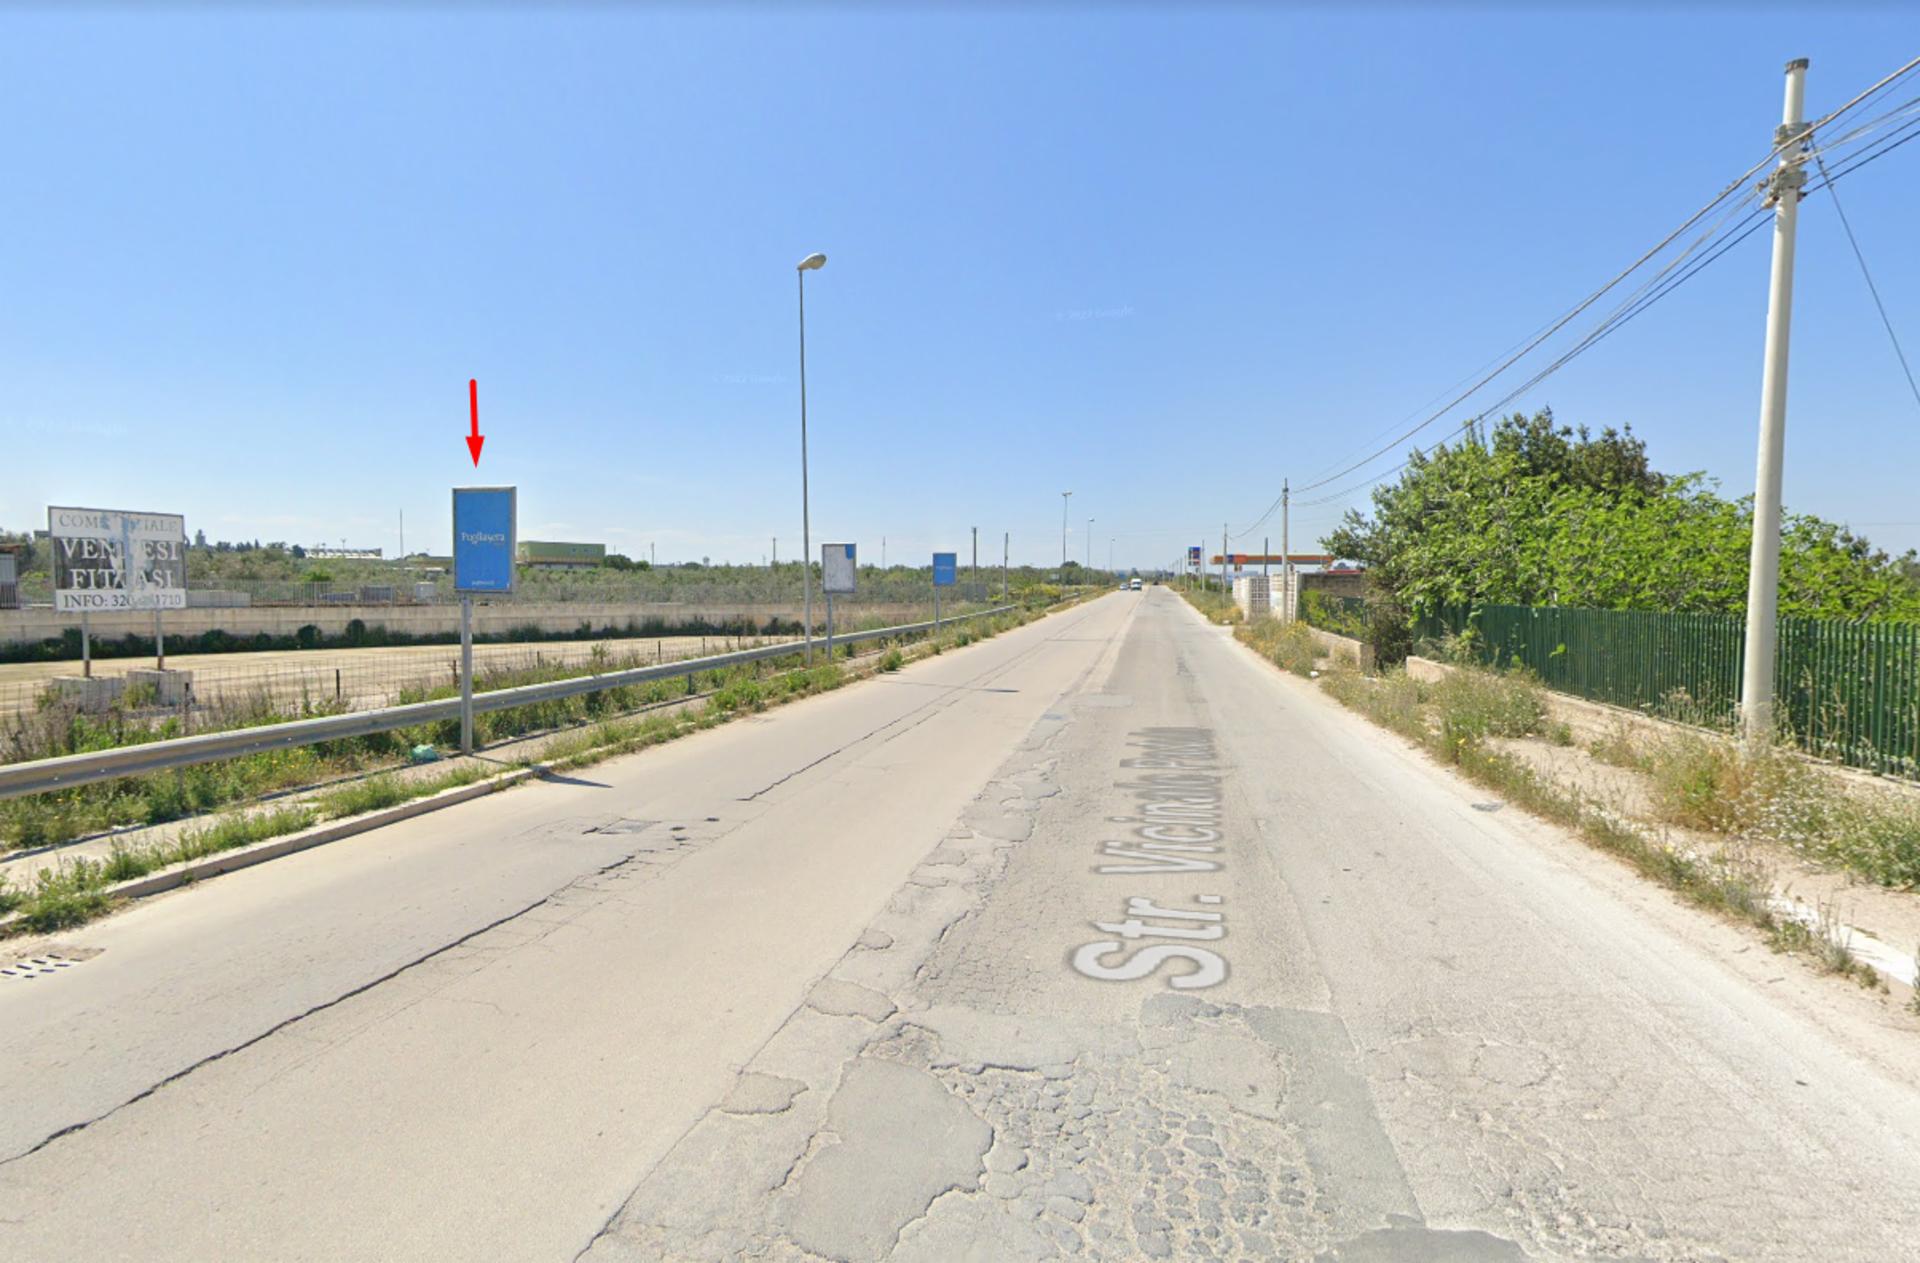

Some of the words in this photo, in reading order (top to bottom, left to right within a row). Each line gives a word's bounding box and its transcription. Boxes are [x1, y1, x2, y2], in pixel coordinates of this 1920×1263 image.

[60, 537, 179, 561] VENESI
[69, 568, 174, 590] FITASI
[63, 594, 108, 608] INFO:
